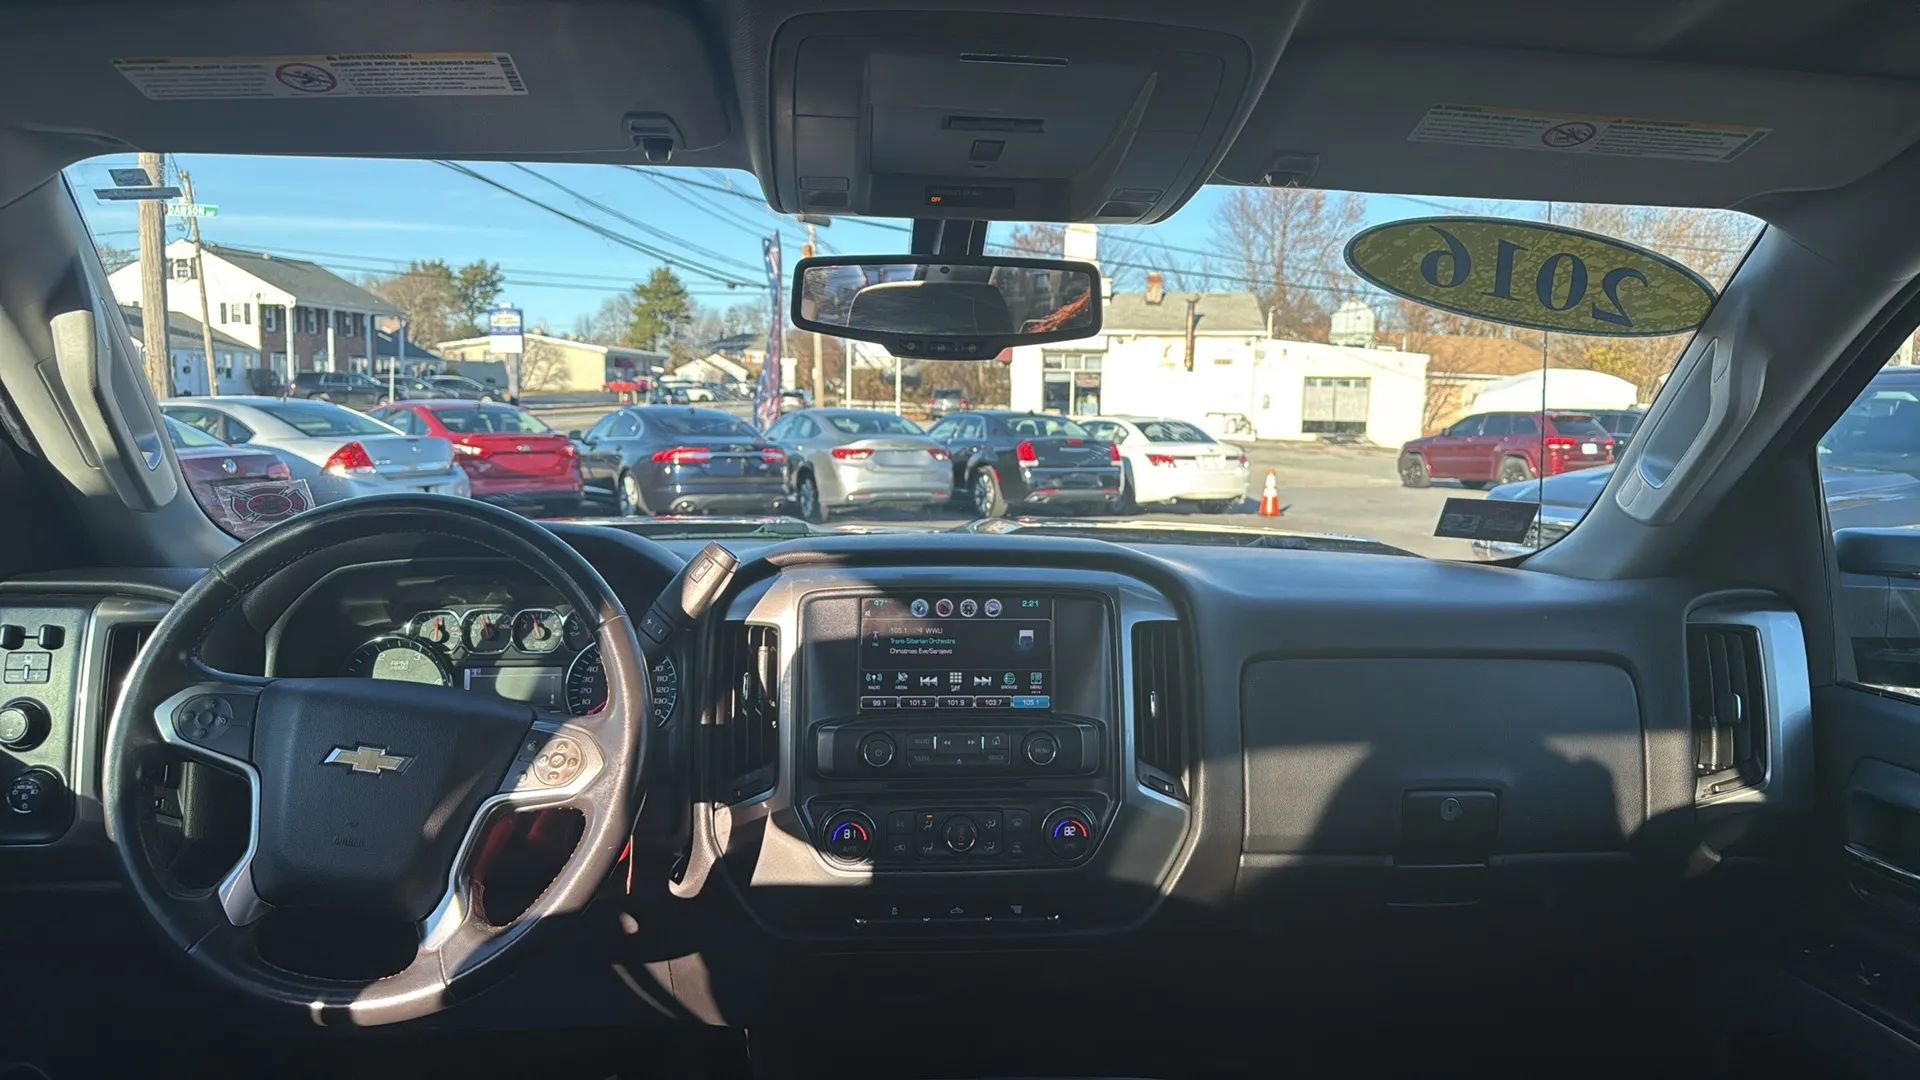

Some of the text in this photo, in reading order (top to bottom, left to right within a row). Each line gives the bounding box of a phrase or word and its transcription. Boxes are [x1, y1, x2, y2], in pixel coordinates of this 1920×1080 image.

[1022, 600, 1039, 608] 2:21
[844, 829, 857, 840] 81
[1063, 826, 1076, 837] 82
